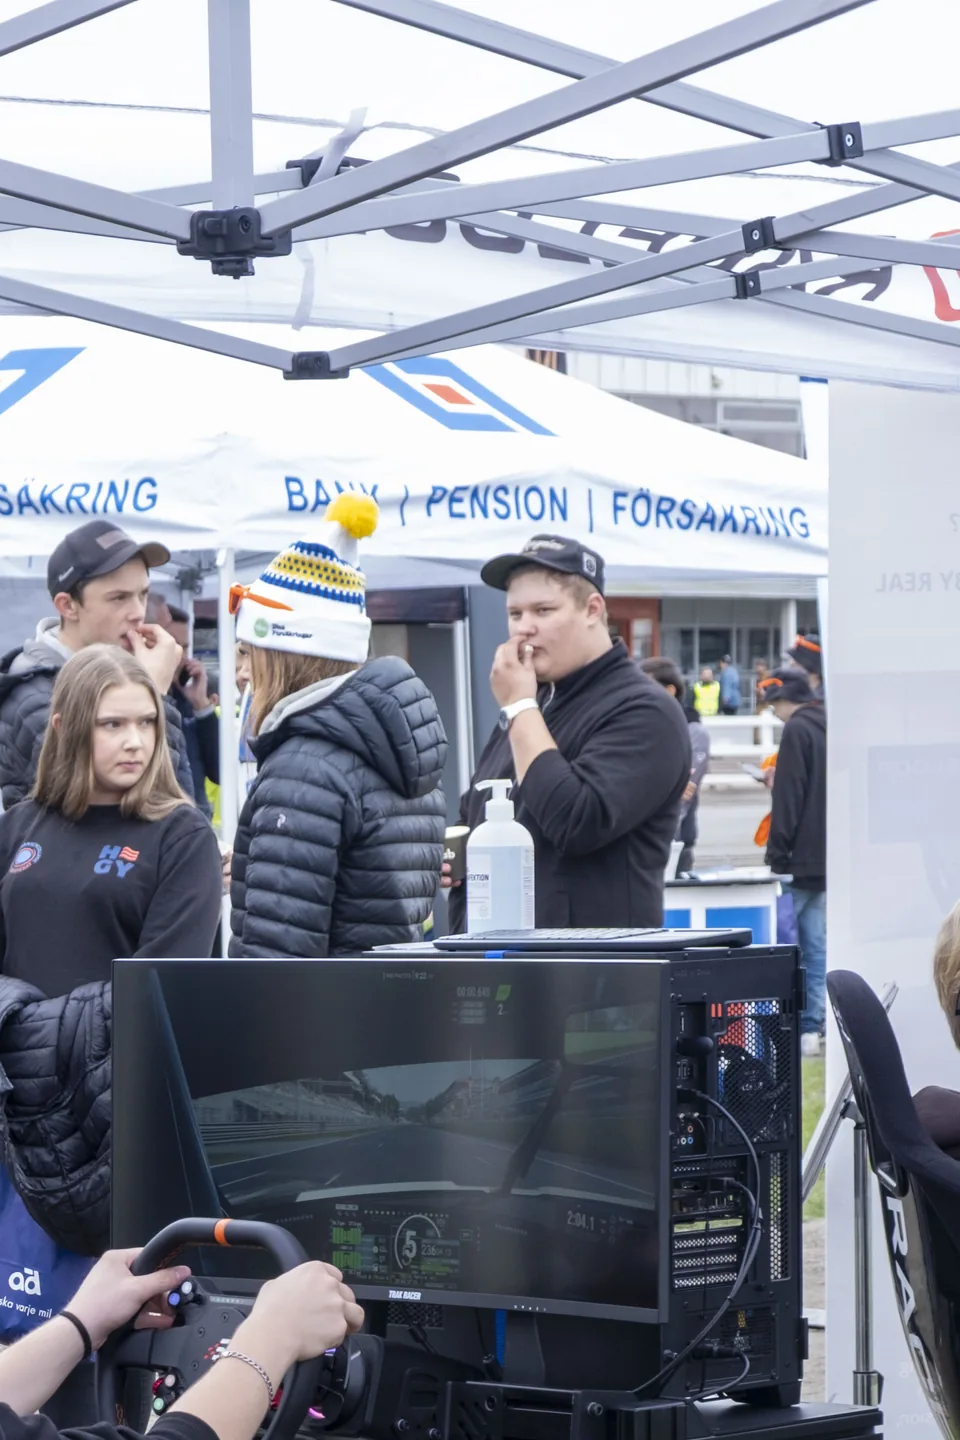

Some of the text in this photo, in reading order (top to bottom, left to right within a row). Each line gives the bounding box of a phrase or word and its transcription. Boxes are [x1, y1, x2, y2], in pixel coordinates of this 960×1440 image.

[426, 484, 569, 522] PENSION
[15, 1303, 37, 1317] varje
[38, 1308, 53, 1319] mil
